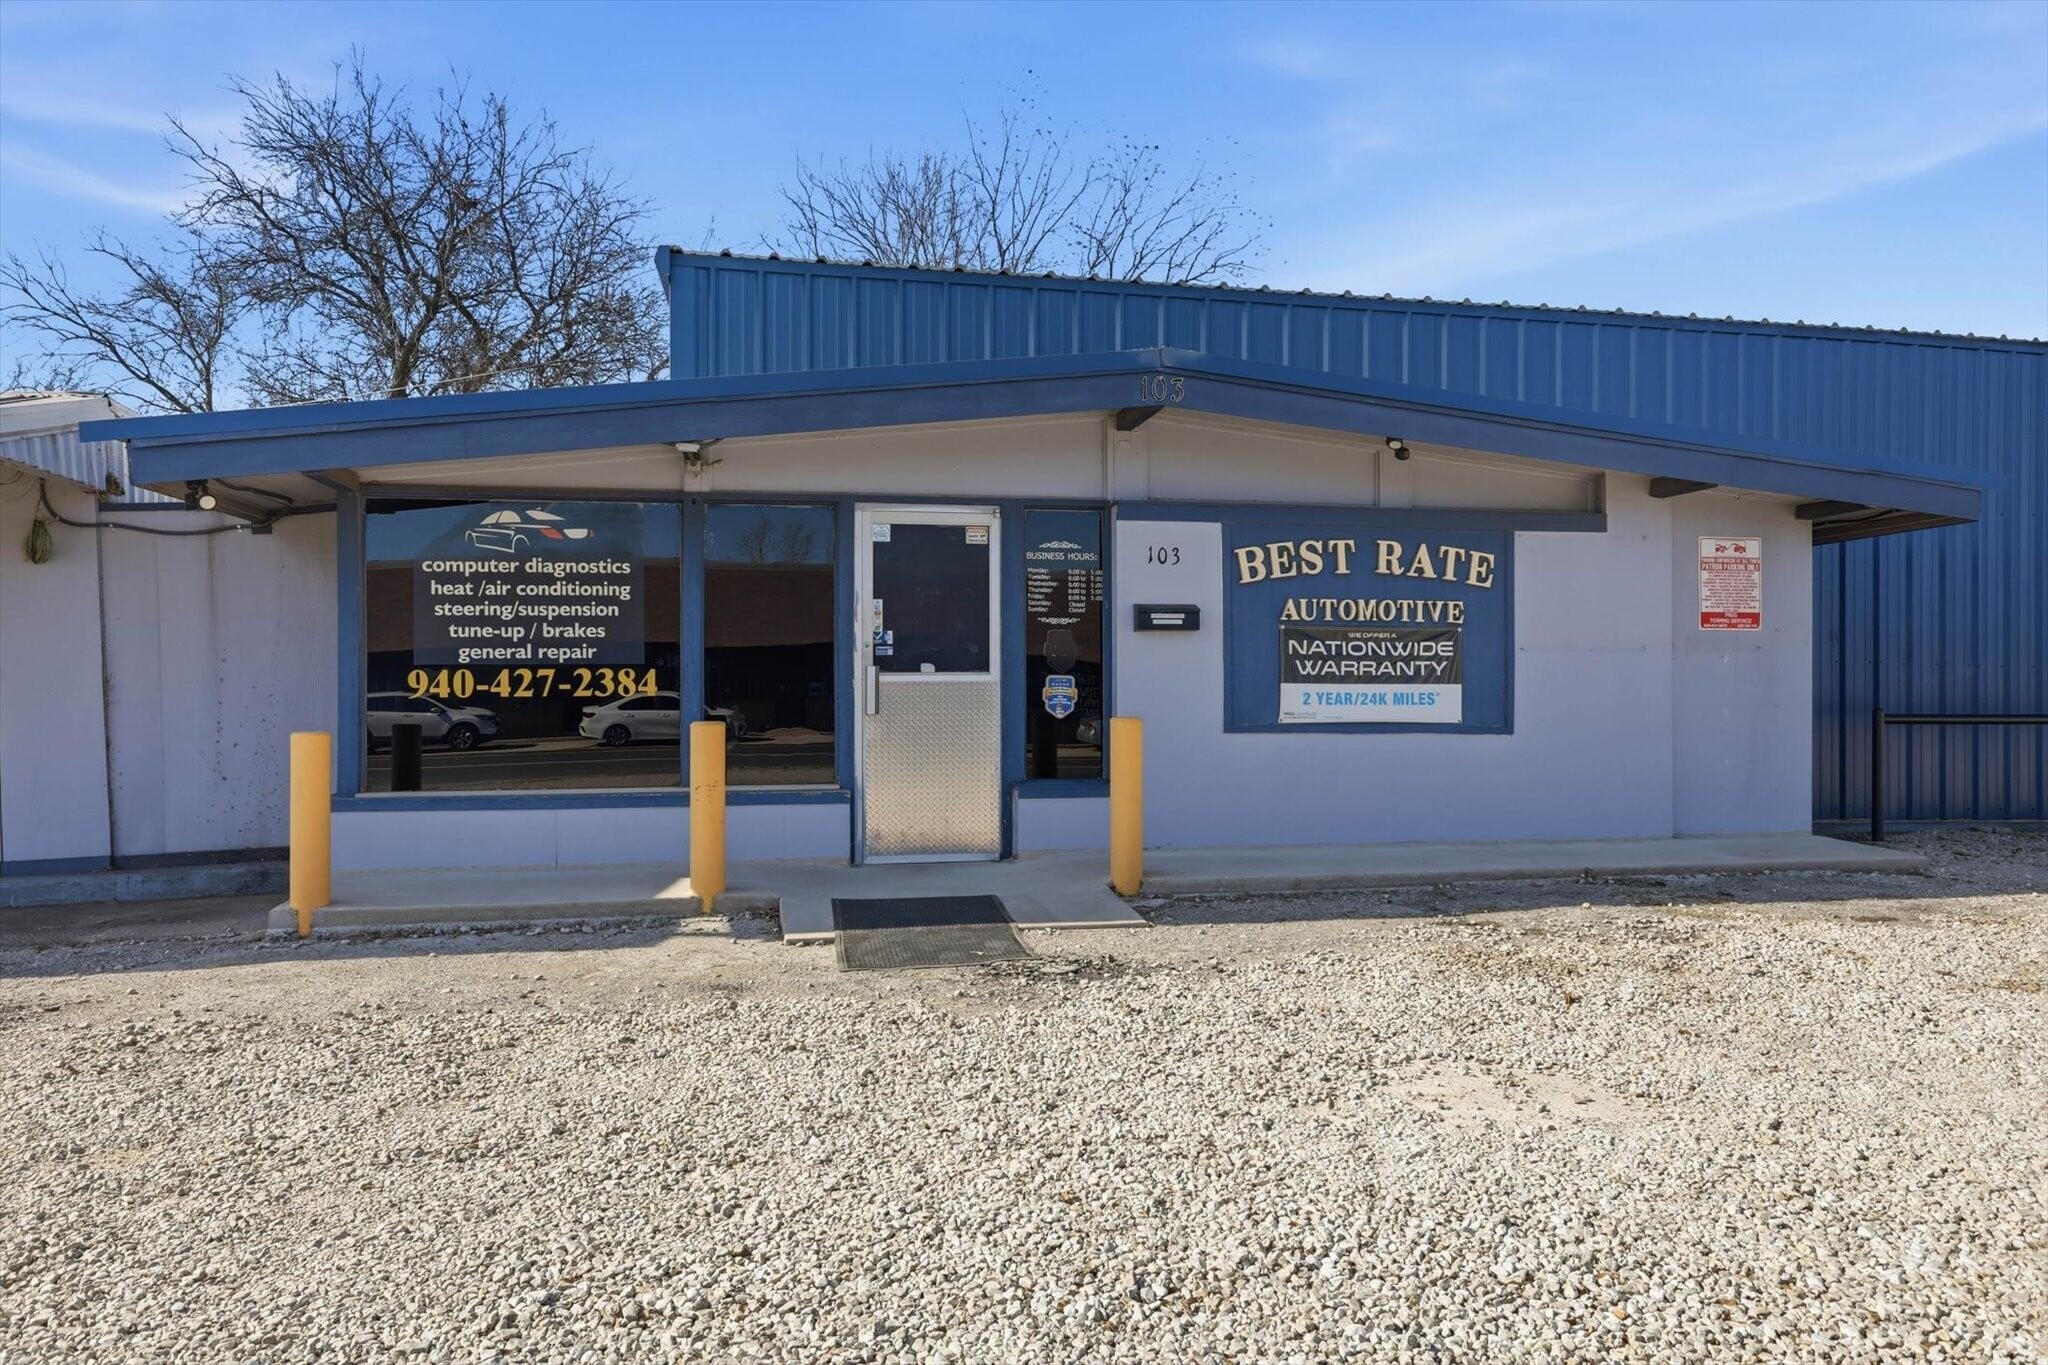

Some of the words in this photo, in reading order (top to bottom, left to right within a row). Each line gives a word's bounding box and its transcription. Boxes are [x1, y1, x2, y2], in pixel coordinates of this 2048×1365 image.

[1141, 375, 1185, 402] 103
[1026, 551, 1065, 560] BUSINESS
[1067, 552, 1098, 560] HOURS:
[1147, 545, 1181, 566] 103
[1233, 539, 1356, 584] BEST
[1375, 539, 1496, 589] RATE
[421, 558, 519, 577] computer
[524, 557, 631, 577] diagnostics
[430, 580, 474, 596] heat
[516, 581, 631, 600] conditioning
[434, 601, 619, 620] steering/suspension
[1279, 598, 1465, 624] AUTOMOTIVE
[449, 623, 525, 641] tune-up
[542, 622, 606, 638] brakes
[458, 643, 532, 663] general
[538, 643, 597, 663] repair
[1288, 640, 1454, 656] NATIONWIDE
[1295, 660, 1448, 676] WARRANTY
[407, 668, 658, 699] 940-427-2384
[1302, 692, 1311, 705] 2
[1316, 692, 1388, 706] YEAR/24K
